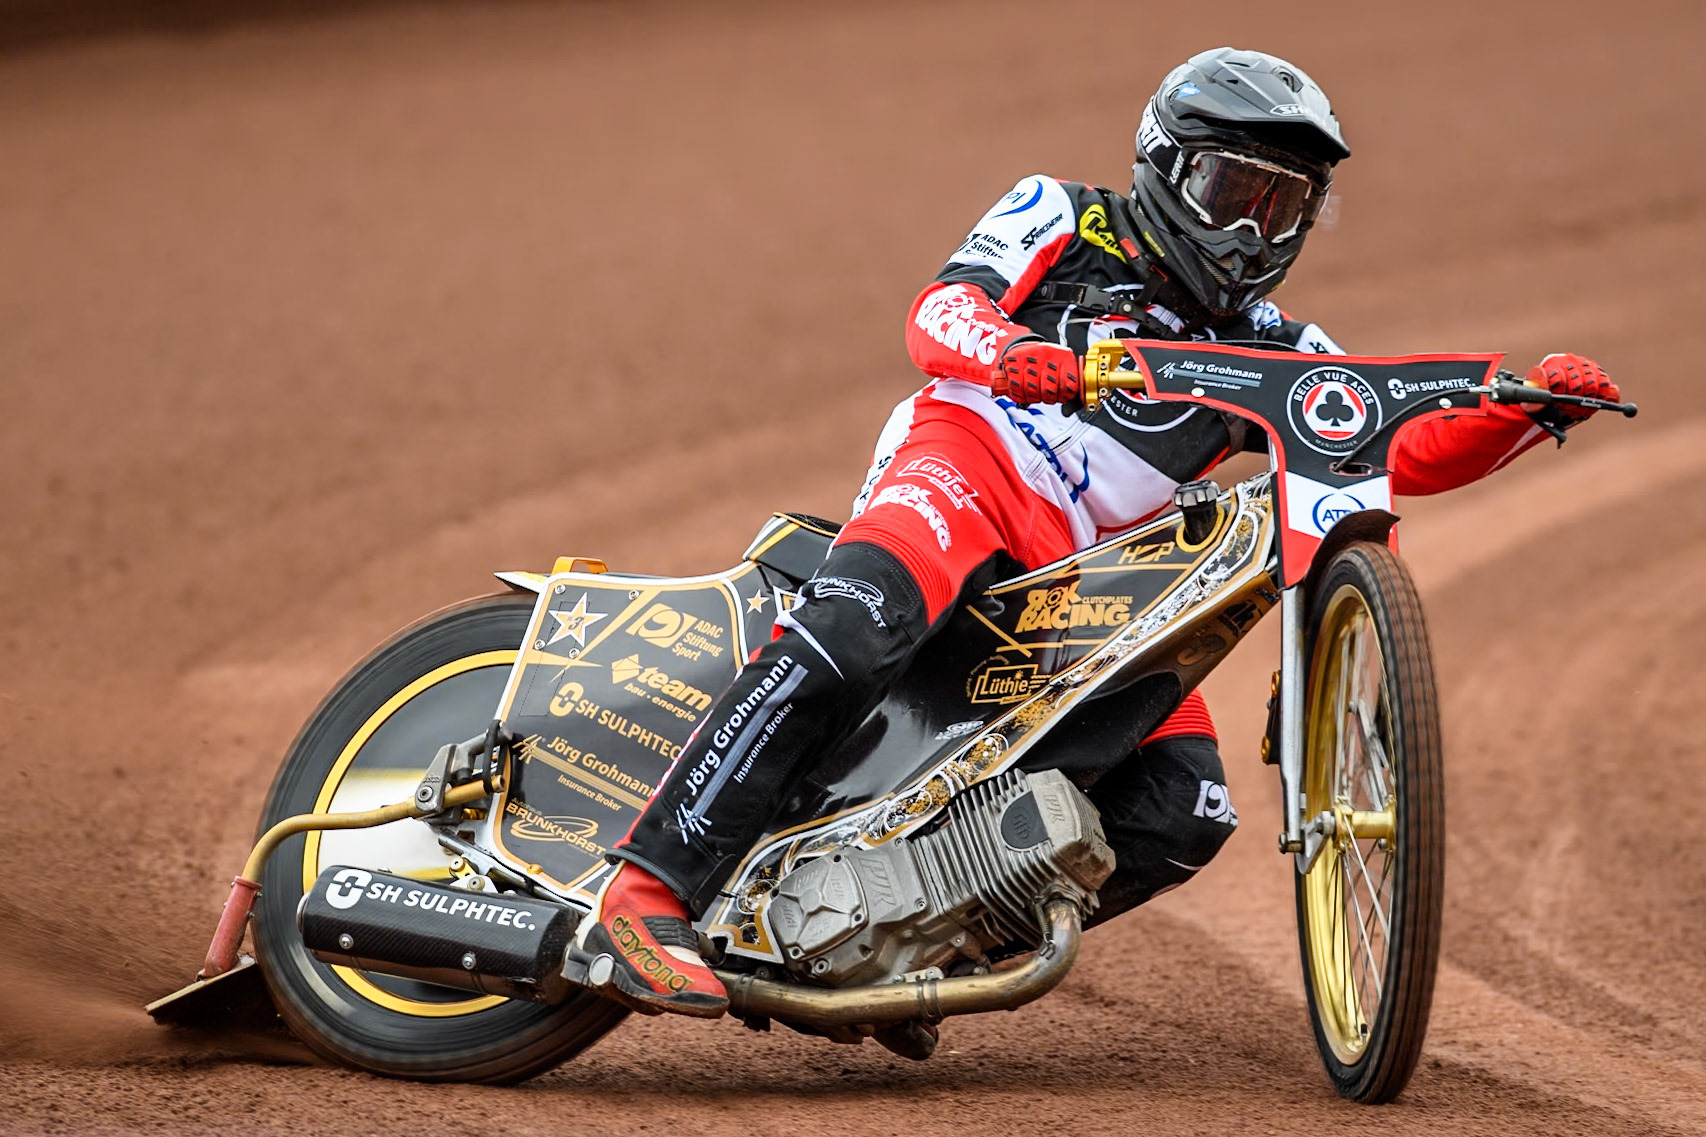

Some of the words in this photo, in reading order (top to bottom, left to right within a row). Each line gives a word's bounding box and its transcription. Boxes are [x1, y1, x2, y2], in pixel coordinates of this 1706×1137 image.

[981, 234, 1008, 251] ADAC
[1180, 360, 1204, 373] Jörg
[1206, 364, 1263, 380] Grohmann
[1294, 374, 1320, 402] BELLE
[1323, 372, 1348, 383] VUE
[1350, 381, 1374, 405] ACES
[1404, 382, 1420, 393] SH
[1420, 378, 1476, 392] SULPHTEC.
[1110, 394, 1138, 417] ESTER
[1315, 439, 1358, 449] MANCHESTER
[907, 462, 965, 495] Lüthje
[1082, 595, 1133, 605] CLUTCHPLATES
[693, 619, 724, 639] ADAC
[1015, 603, 1131, 634] RACING
[671, 641, 702, 663] Sport
[683, 631, 724, 659] Stiftung
[637, 666, 713, 711] team
[979, 674, 1029, 697] Lüthje
[575, 699, 600, 719] SH
[624, 682, 647, 698] bau
[651, 695, 697, 722] energie
[685, 749, 722, 796] Jörg
[713, 654, 793, 750] Grohmann
[547, 736, 582, 764] Jörg
[733, 732, 770, 784] Insurance
[765, 702, 794, 735] Broker
[557, 774, 596, 799] Insurance
[595, 793, 622, 812] Broker
[506, 802, 607, 855] BRUNKHORST
[366, 882, 403, 903] SH
[403, 889, 536, 931] SULPHTEC.
[611, 914, 694, 993] daytona
